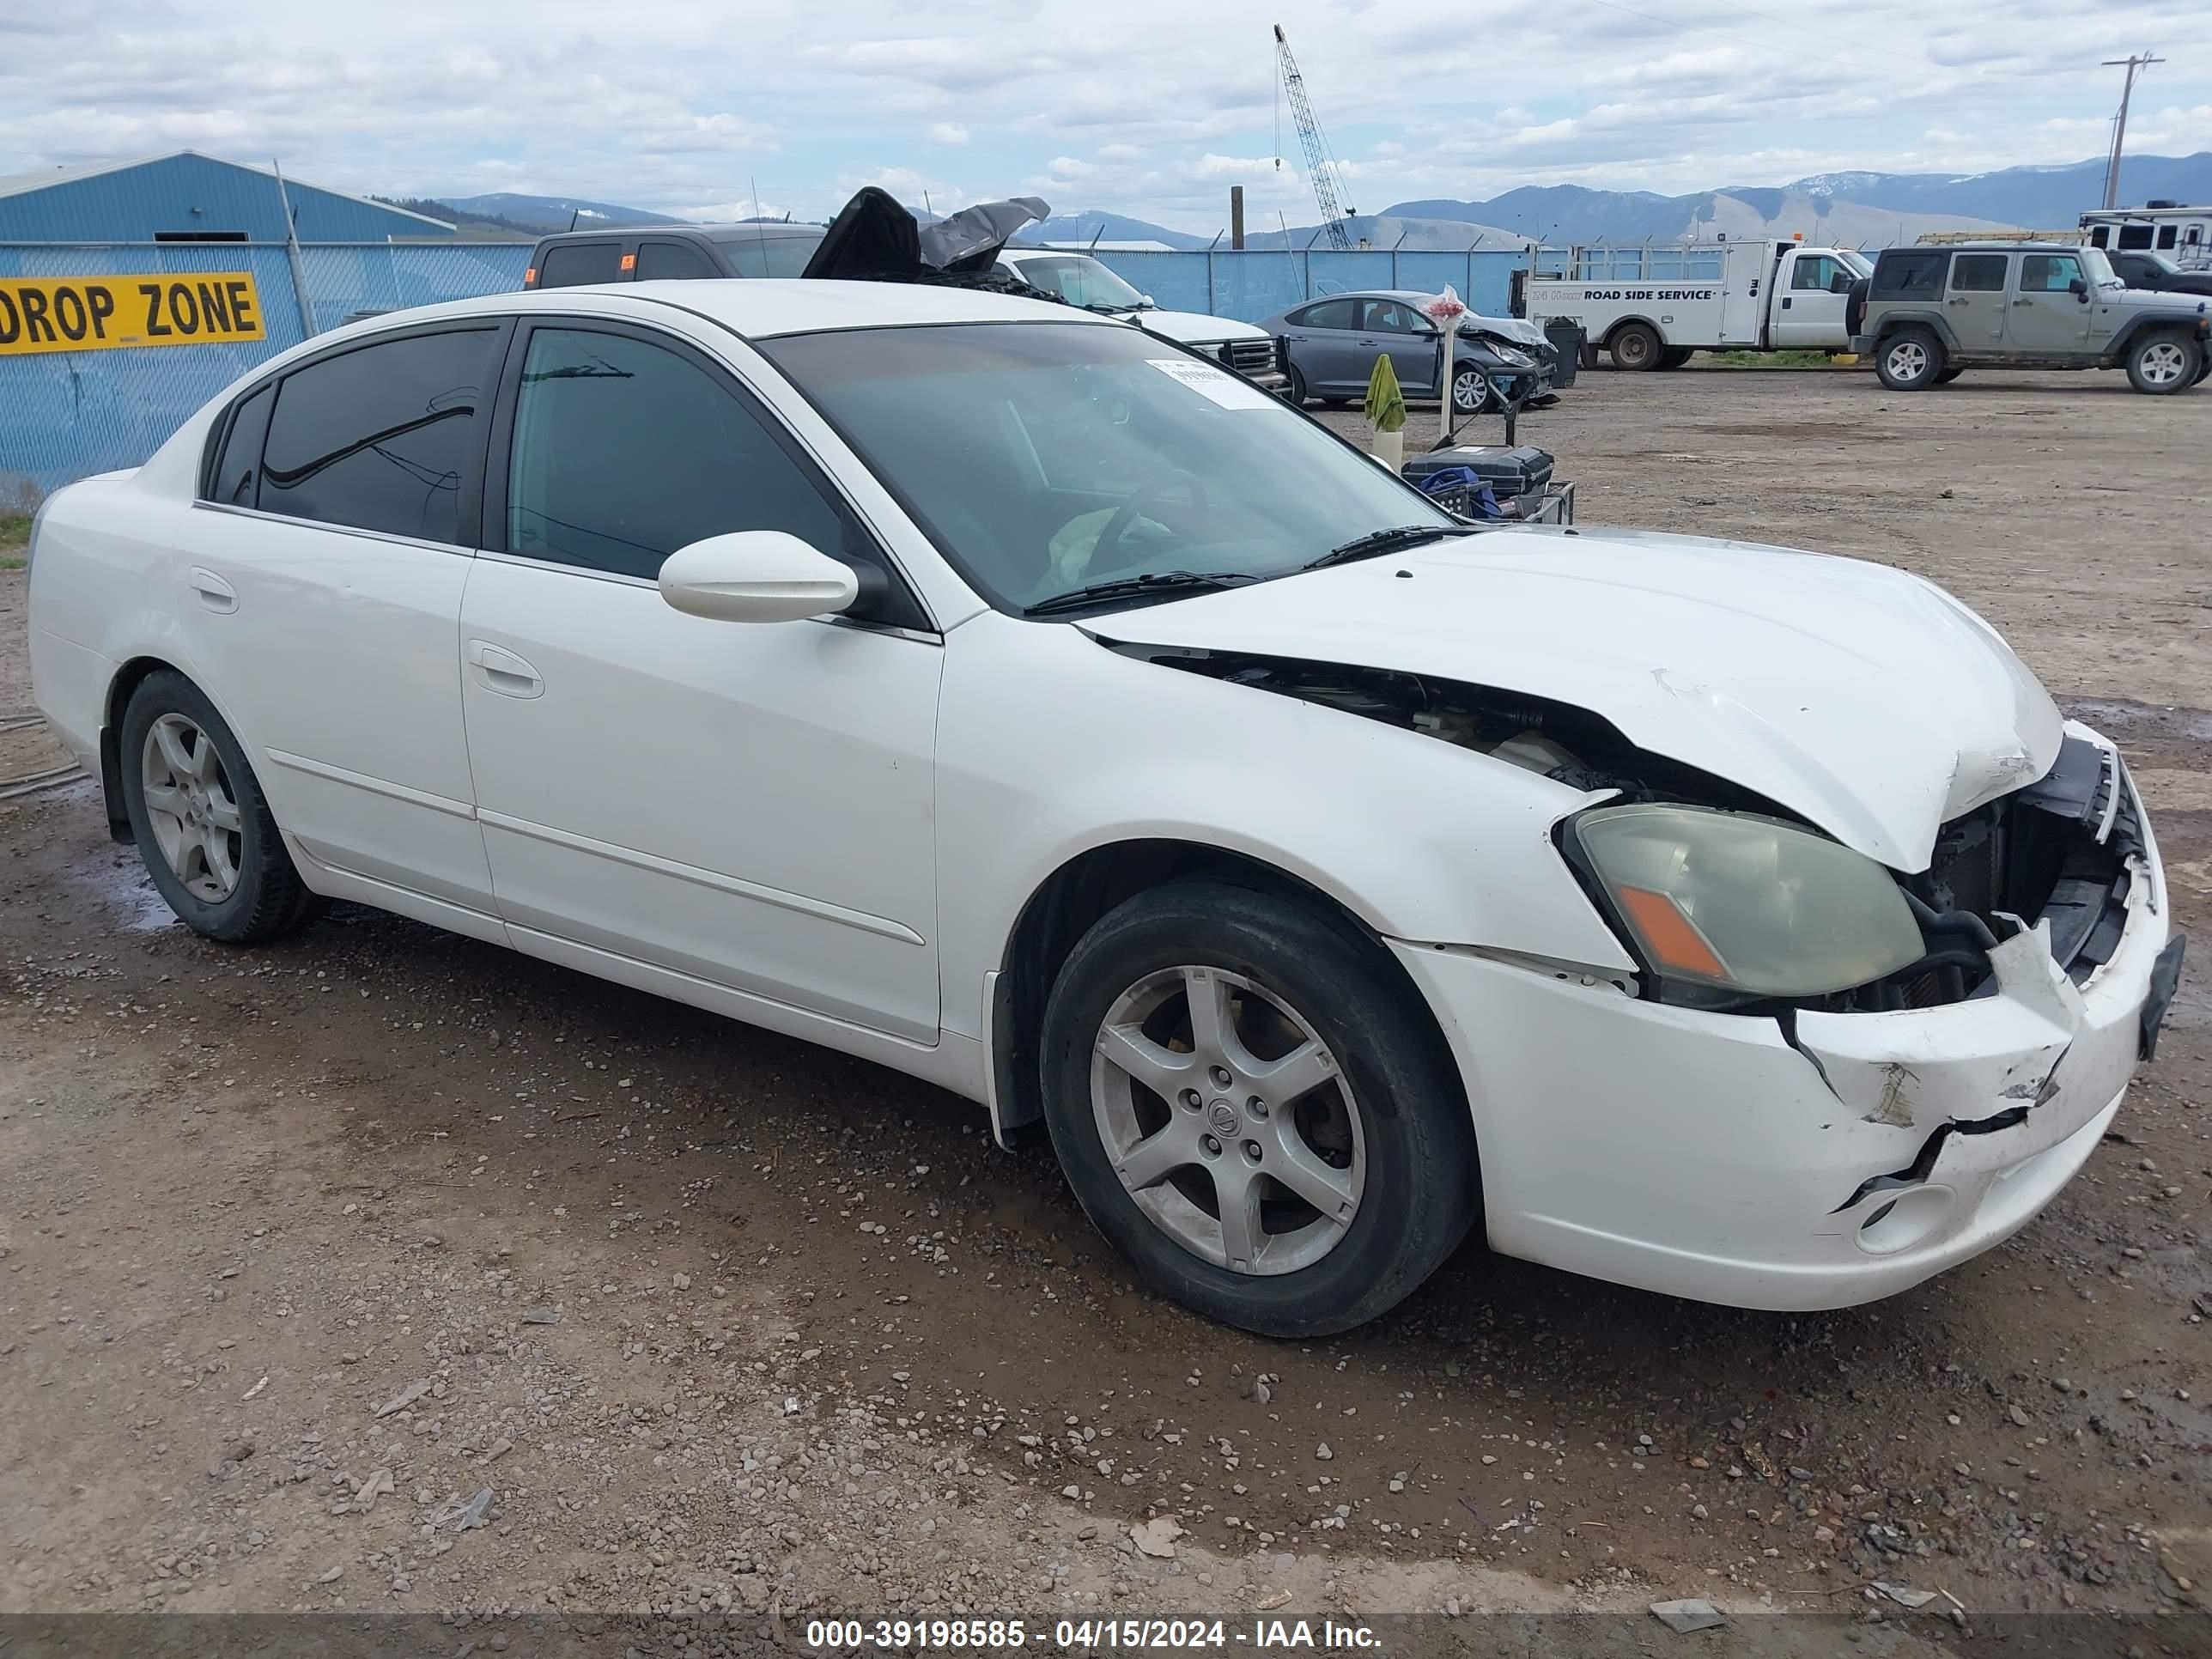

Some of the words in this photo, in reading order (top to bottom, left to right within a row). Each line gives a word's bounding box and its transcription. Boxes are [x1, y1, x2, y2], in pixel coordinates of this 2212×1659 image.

[0, 286, 114, 343] DROP
[137, 282, 257, 336] ZONE
[1532, 291, 1547, 301] 24
[1552, 291, 1582, 301] Hour
[1584, 290, 1621, 301] ROAD
[1625, 290, 1654, 301] SIDE
[1657, 290, 1712, 301] SERVICE
